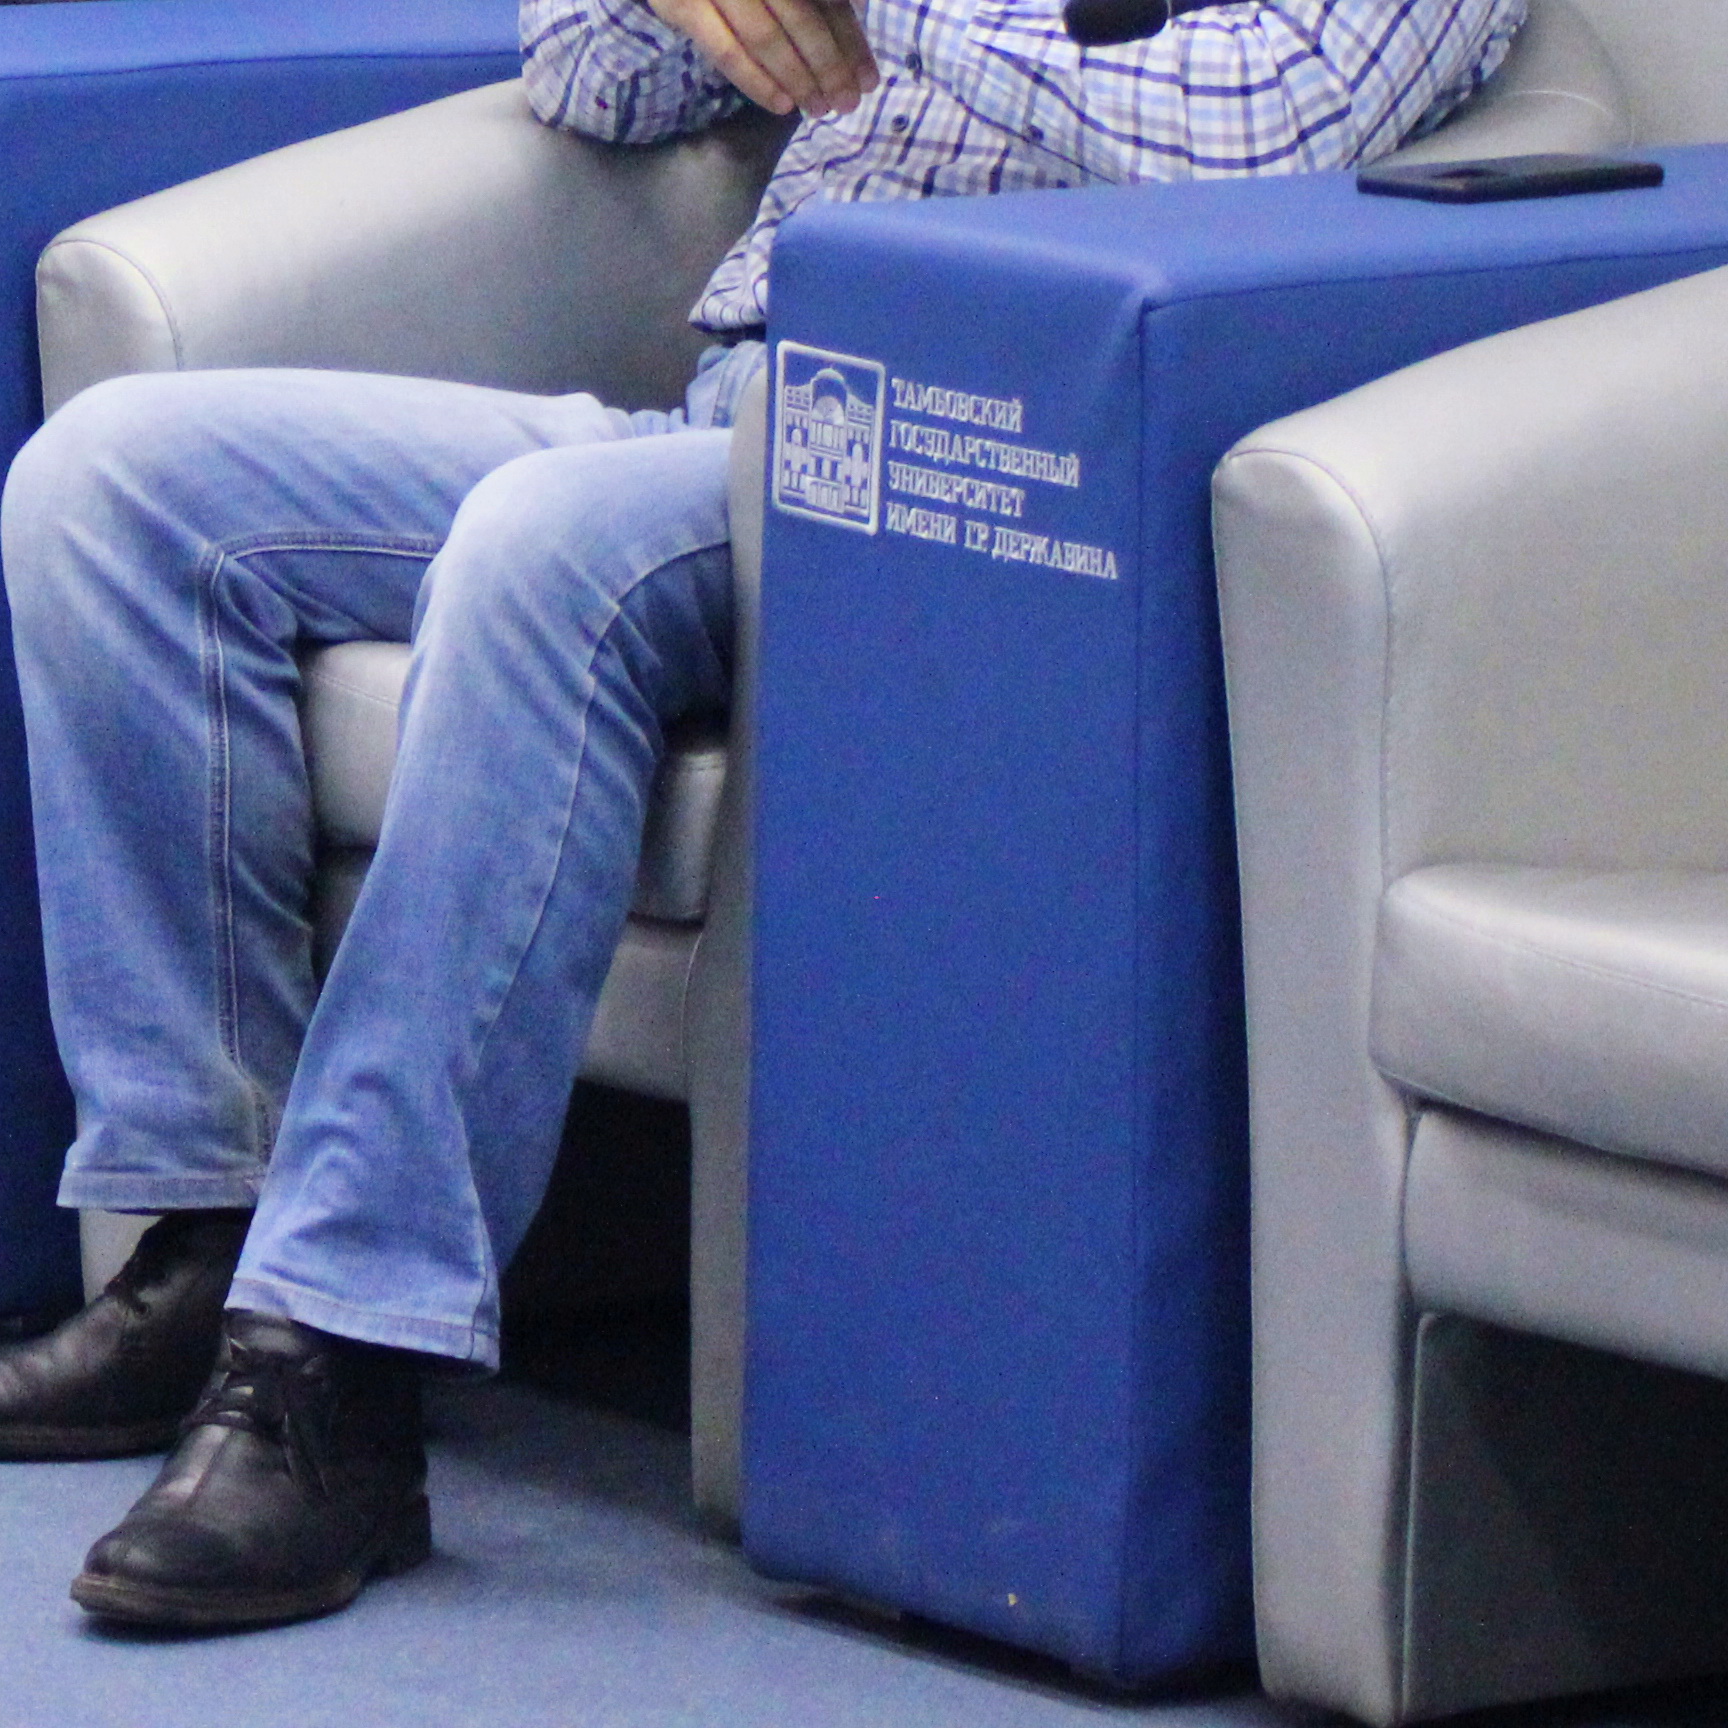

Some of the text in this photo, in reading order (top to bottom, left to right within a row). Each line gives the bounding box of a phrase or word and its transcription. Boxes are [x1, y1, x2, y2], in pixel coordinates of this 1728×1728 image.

[891, 377, 1023, 433] ТАМБОВСКИЙ
[889, 420, 1080, 488] ГОСУДАРСТВЕННЫЙ
[887, 460, 1026, 518] УНИВЕРСИТЕТ
[885, 501, 958, 545] ИМЕНИ
[990, 525, 1119, 581] ДЕРЖАВИНА
